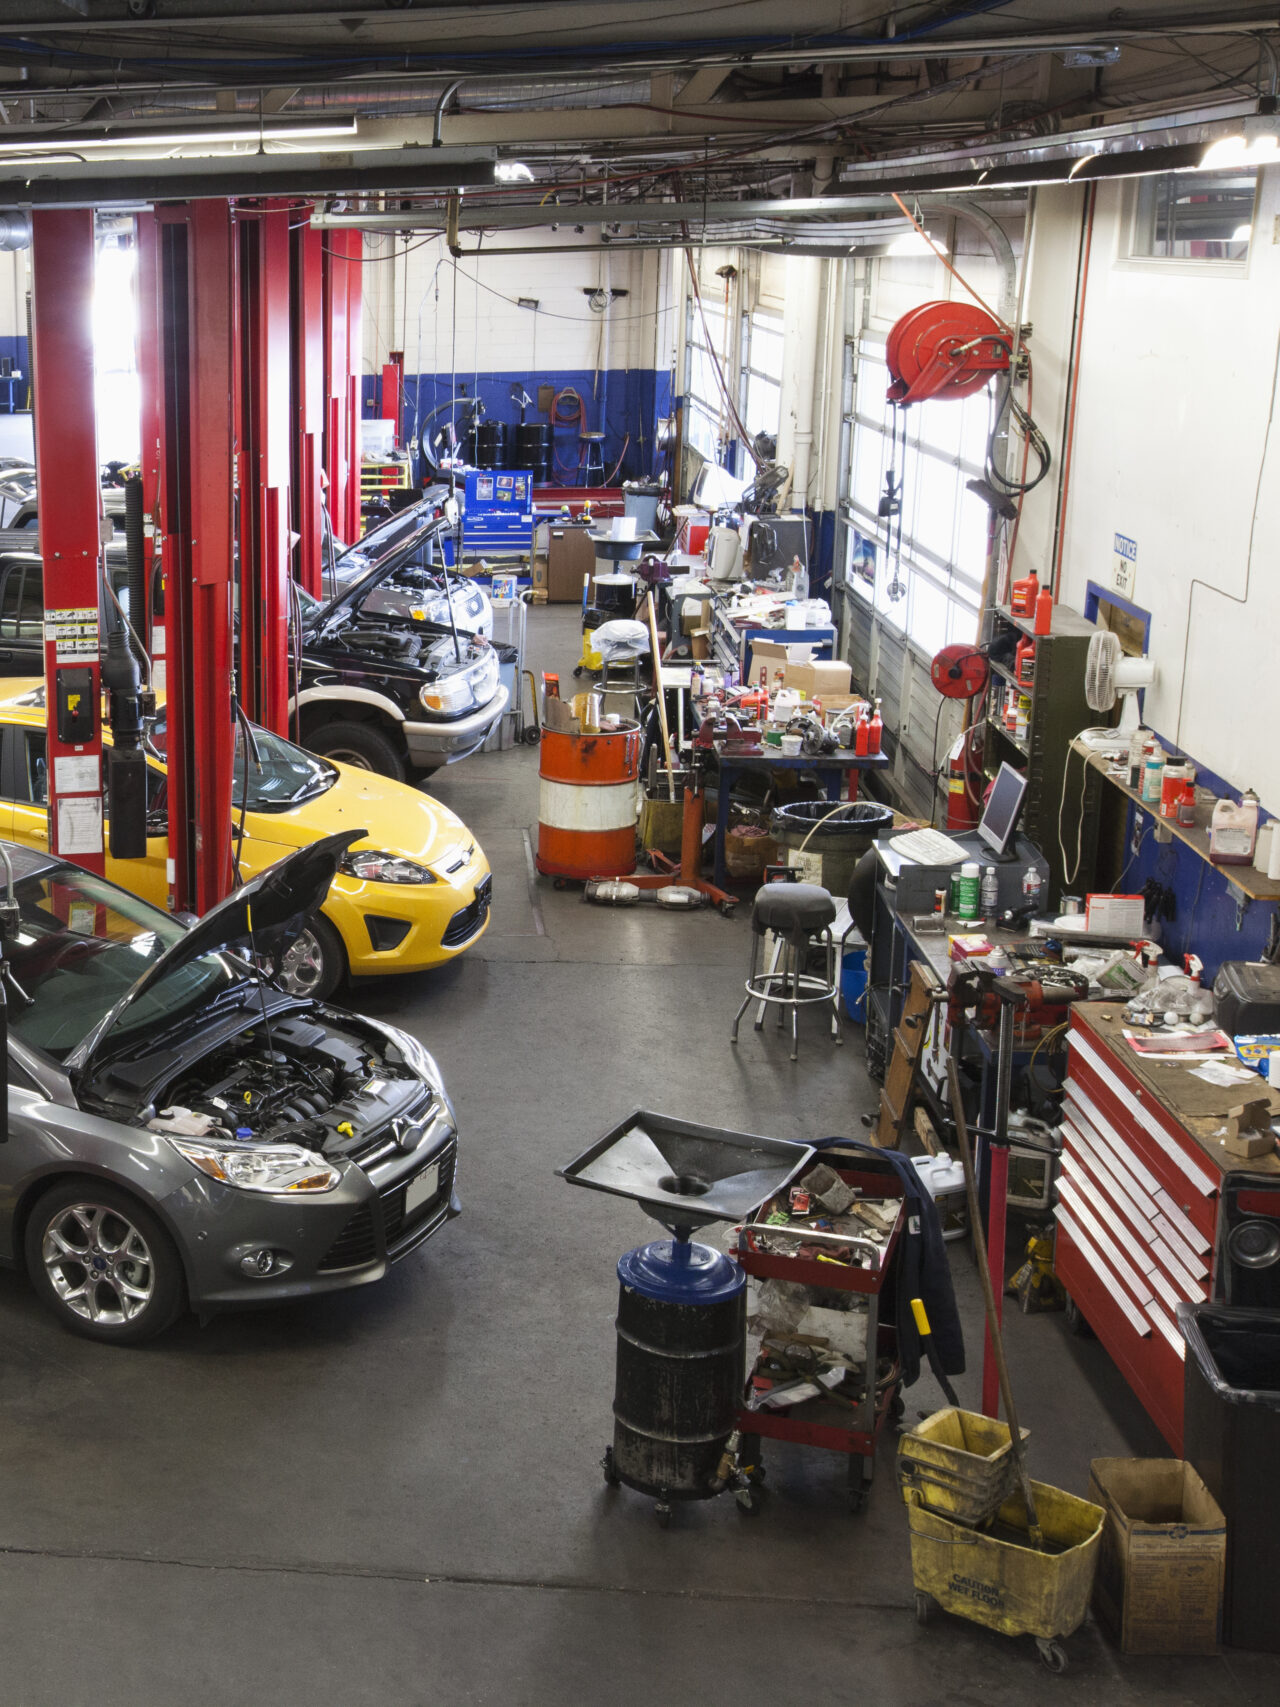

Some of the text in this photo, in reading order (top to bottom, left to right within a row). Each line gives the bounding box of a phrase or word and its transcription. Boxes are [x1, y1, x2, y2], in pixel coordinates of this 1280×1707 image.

[1114, 535, 1137, 560] NOTICE
[1120, 559, 1128, 574] NO
[1116, 573, 1128, 590] EXIT
[948, 1581, 1005, 1609] WET FLOOR
[952, 1573, 1000, 1597] CAUTION
